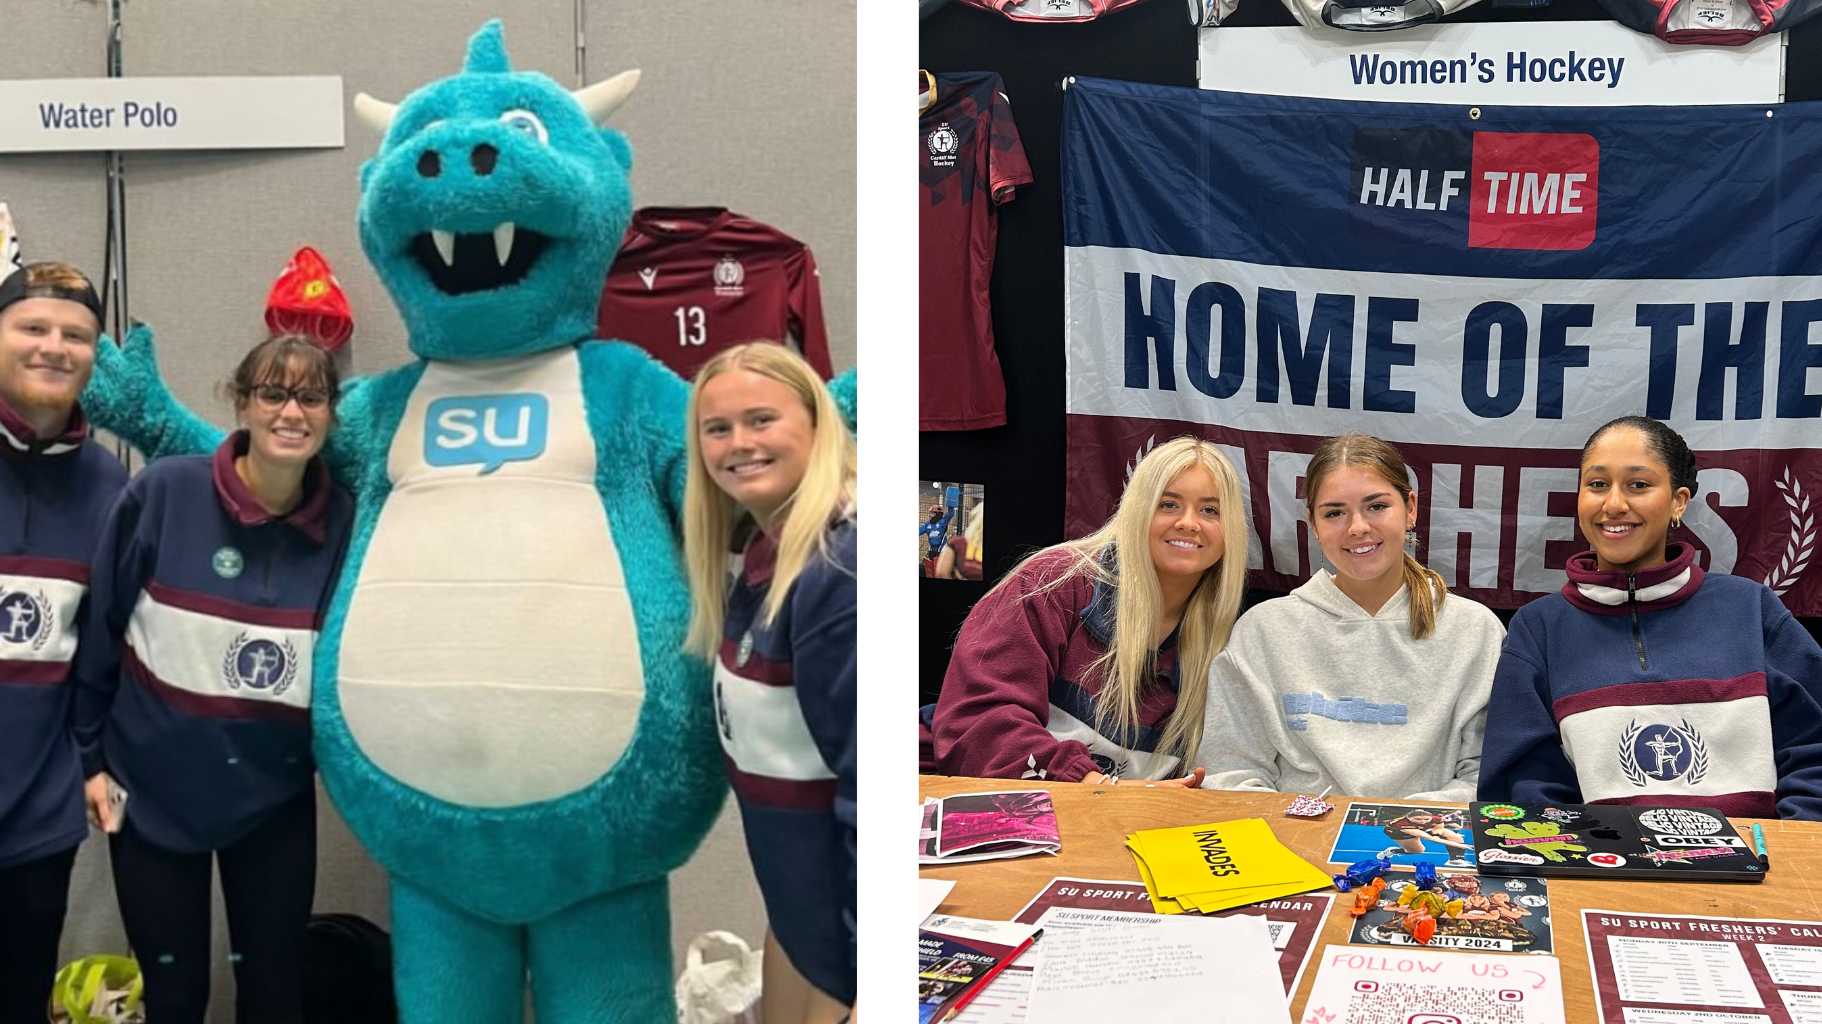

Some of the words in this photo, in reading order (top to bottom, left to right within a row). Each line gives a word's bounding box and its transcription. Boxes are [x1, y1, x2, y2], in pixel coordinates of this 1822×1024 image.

[1349, 52, 1495, 85] Women's
[1506, 50, 1625, 88] Hockey
[40, 103, 115, 129] Water
[124, 102, 178, 128] Polo
[1360, 166, 1465, 211] HALF
[1483, 171, 1588, 215] TIME
[673, 305, 707, 346] 13
[1124, 272, 1420, 414] HOME
[1460, 301, 1594, 420] OF
[1635, 300, 1822, 421] THE
[435, 406, 531, 449] SU
[1661, 837, 1735, 846] OBEY
[1193, 830, 1240, 877] INVADES
[1058, 888, 1080, 896] SU
[1083, 889, 1134, 900] SPORT
[1100, 915, 1162, 925] MEMBERSHIP
[1601, 917, 1622, 927] SU
[1628, 919, 1681, 931] SPORT
[1689, 922, 1782, 935] FRESHERS'
[1465, 938, 1502, 949] 2024
[1722, 933, 1754, 941] WEEK
[952, 952, 980, 961] FROM
[1331, 954, 1444, 974] FOLLOW
[1471, 963, 1509, 979] US
[1631, 1008, 1692, 1016] WEDNESDAY
